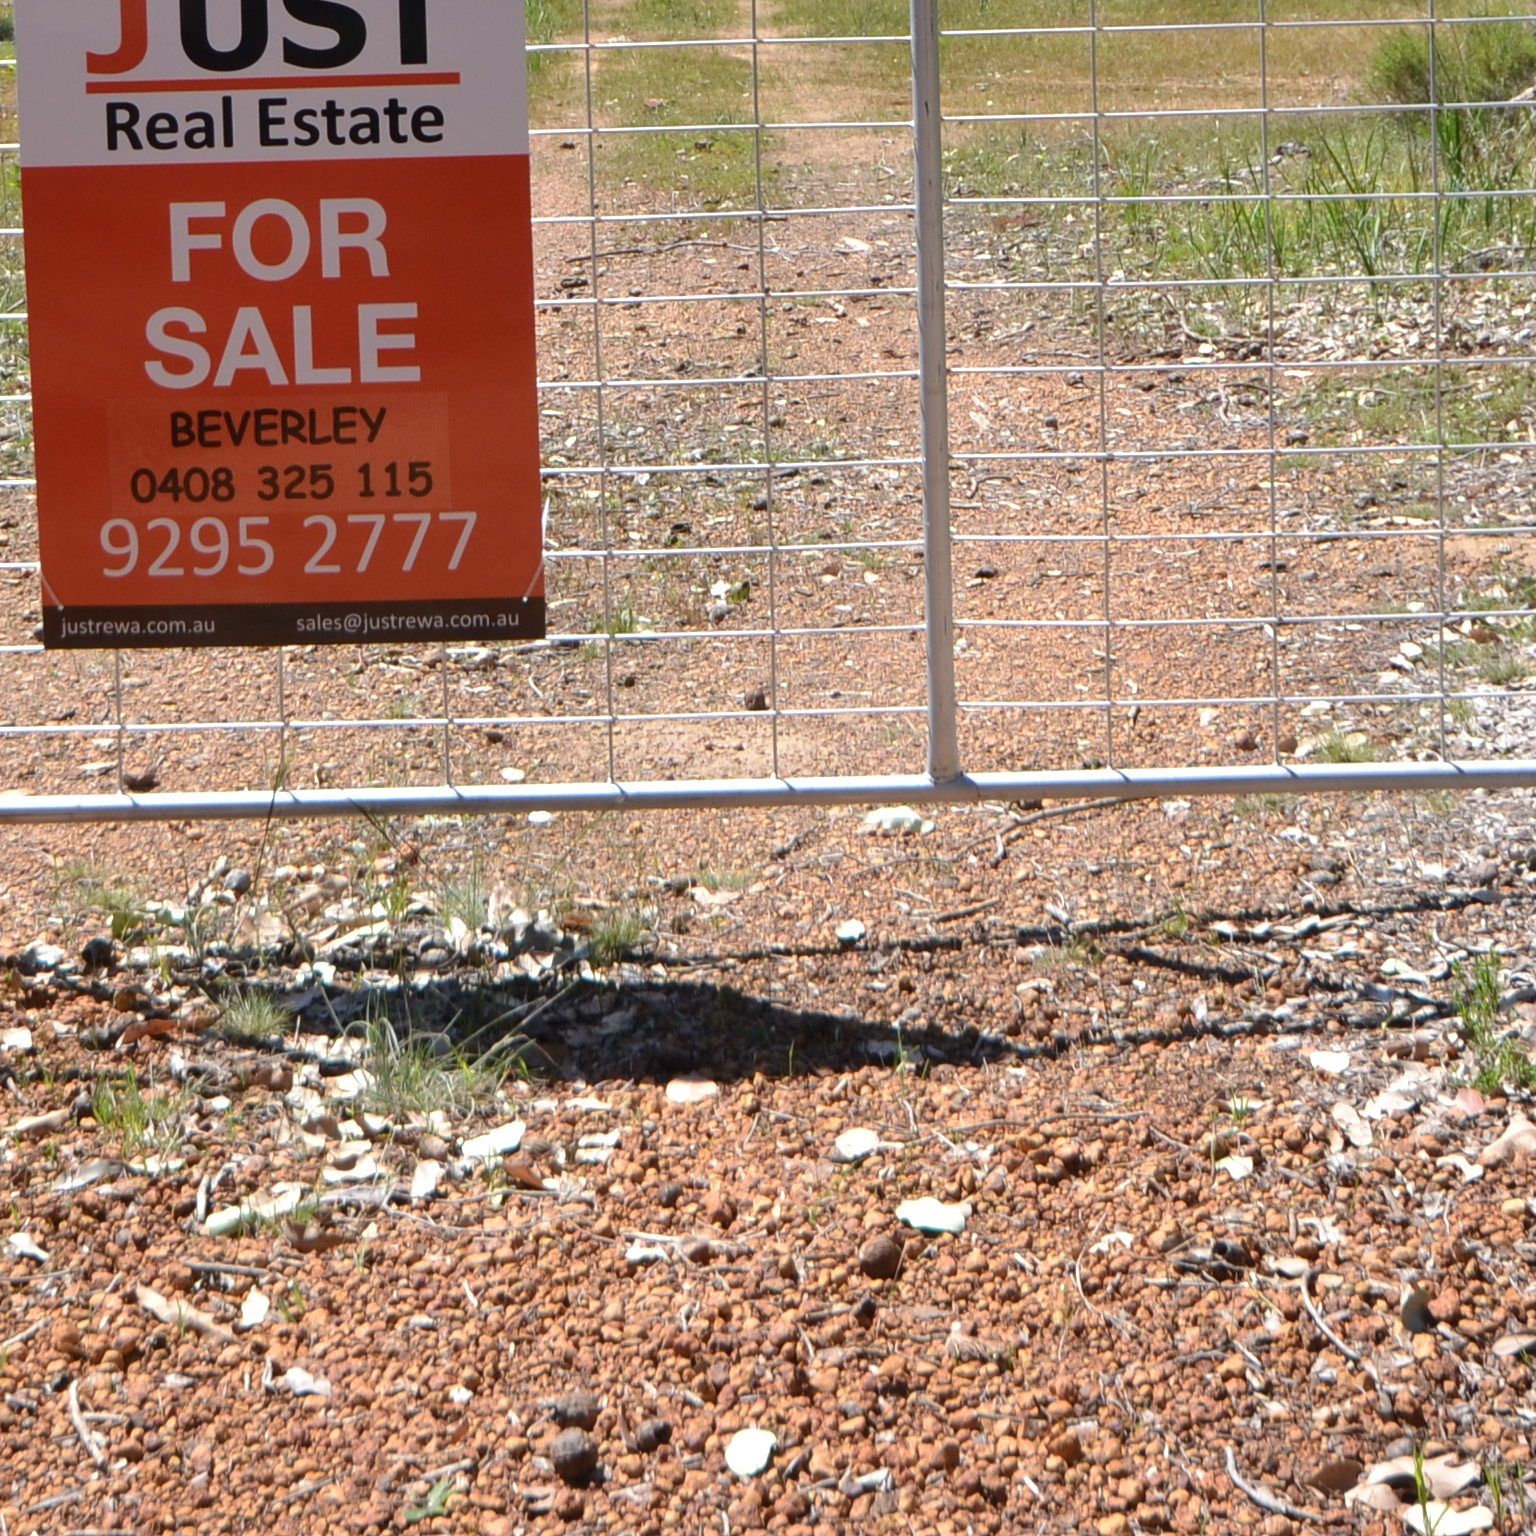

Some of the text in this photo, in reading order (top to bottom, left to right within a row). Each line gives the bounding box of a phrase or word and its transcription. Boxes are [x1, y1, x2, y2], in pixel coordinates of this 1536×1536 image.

[106, 95, 444, 151] Real Estate
[169, 197, 390, 282] FOR
[144, 302, 421, 389] SALE
[170, 406, 387, 448] BEVERLEY
[130, 461, 433, 503] 0408 325 115
[99, 511, 477, 577] 9295 2777
[60, 617, 216, 638] justrewa.com.au
[296, 612, 520, 634] sales@justrewa.com.au
